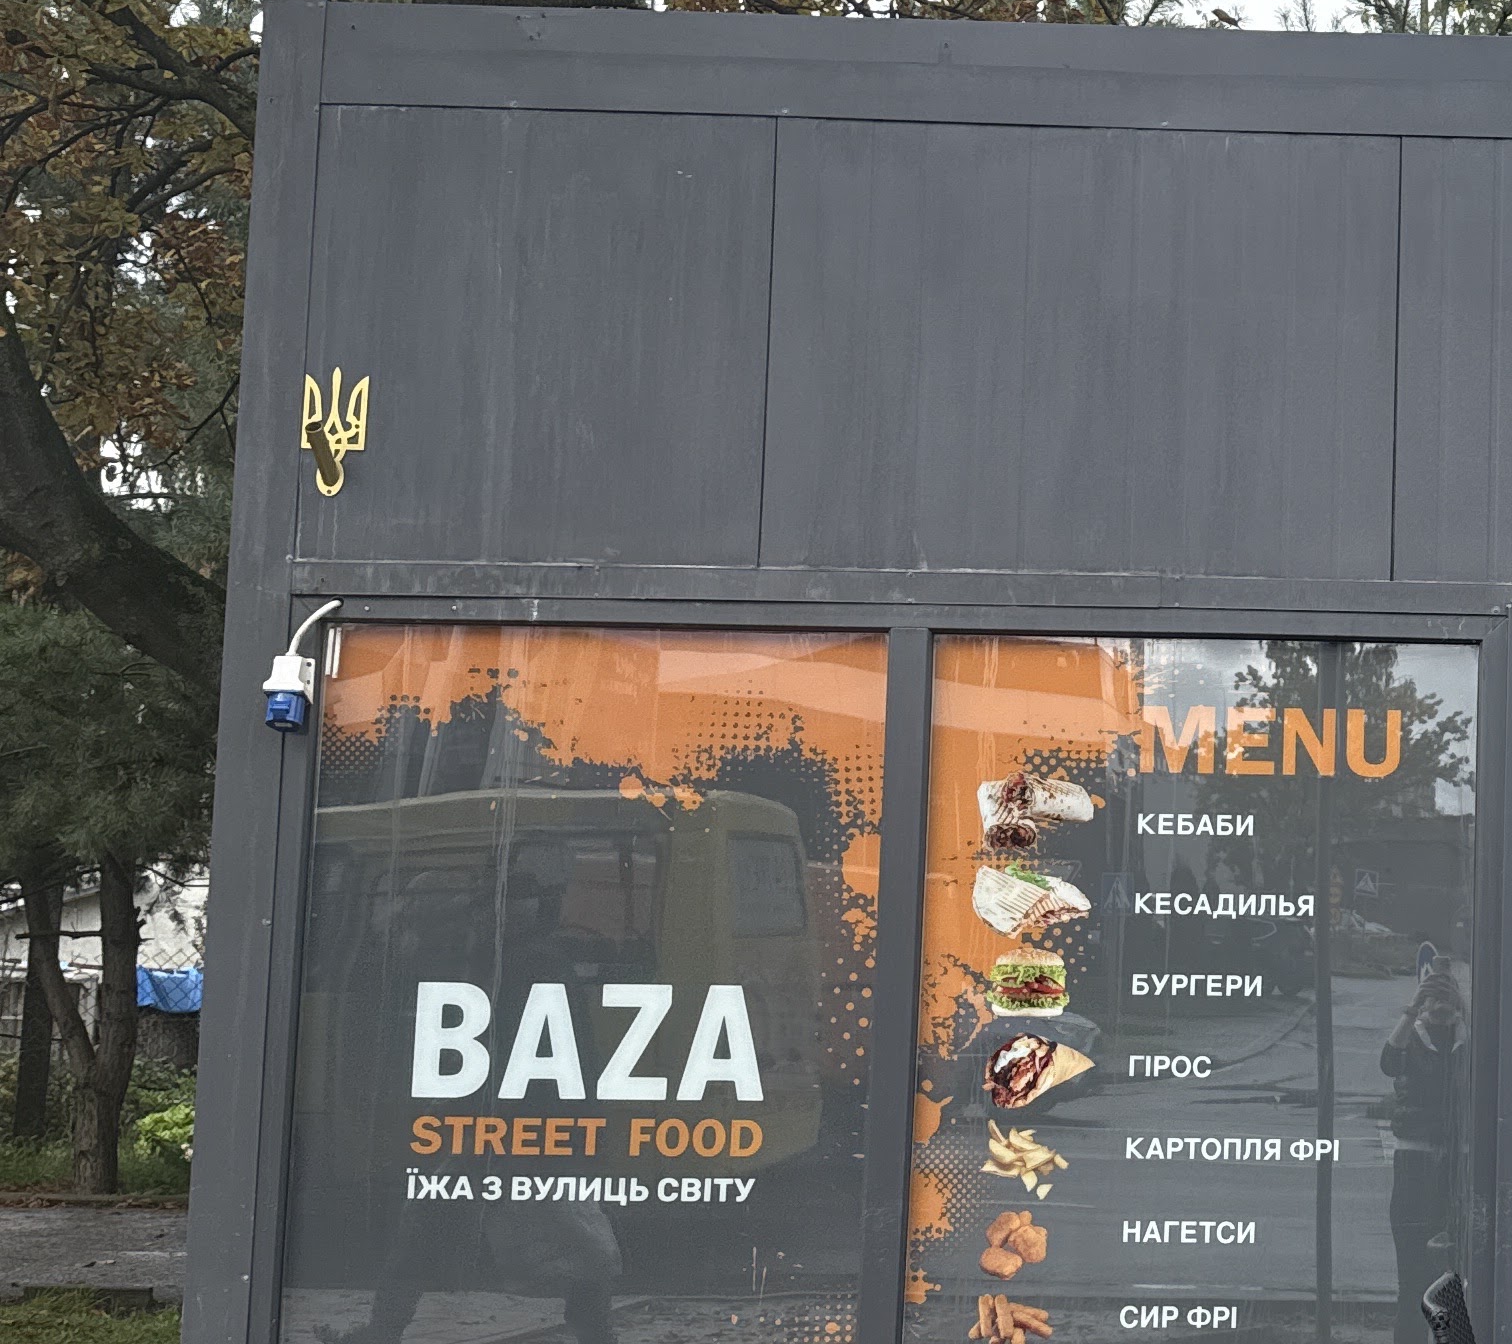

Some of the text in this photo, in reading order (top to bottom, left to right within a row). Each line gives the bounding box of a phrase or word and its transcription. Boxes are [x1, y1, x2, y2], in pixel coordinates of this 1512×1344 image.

[1138, 705, 1402, 778] MENU
[1136, 813, 1254, 836] КЕБАБИ
[1134, 892, 1315, 919] КЕСАДИЛЬЯ
[1131, 973, 1263, 997] БУРГЕРИ
[410, 981, 764, 1102] BAZA
[1128, 1054, 1212, 1078] ГІРОС
[409, 1115, 764, 1158] STREET FOOD
[1125, 1137, 1340, 1162] КАРТОПЛЯ ФРІ
[405, 1167, 756, 1206] ЇЖА З ВУЛИЦЬ СВІТУ
[1122, 1220, 1256, 1244] НАГЕТСИ
[1119, 1305, 1238, 1329] СИР ФРІ
